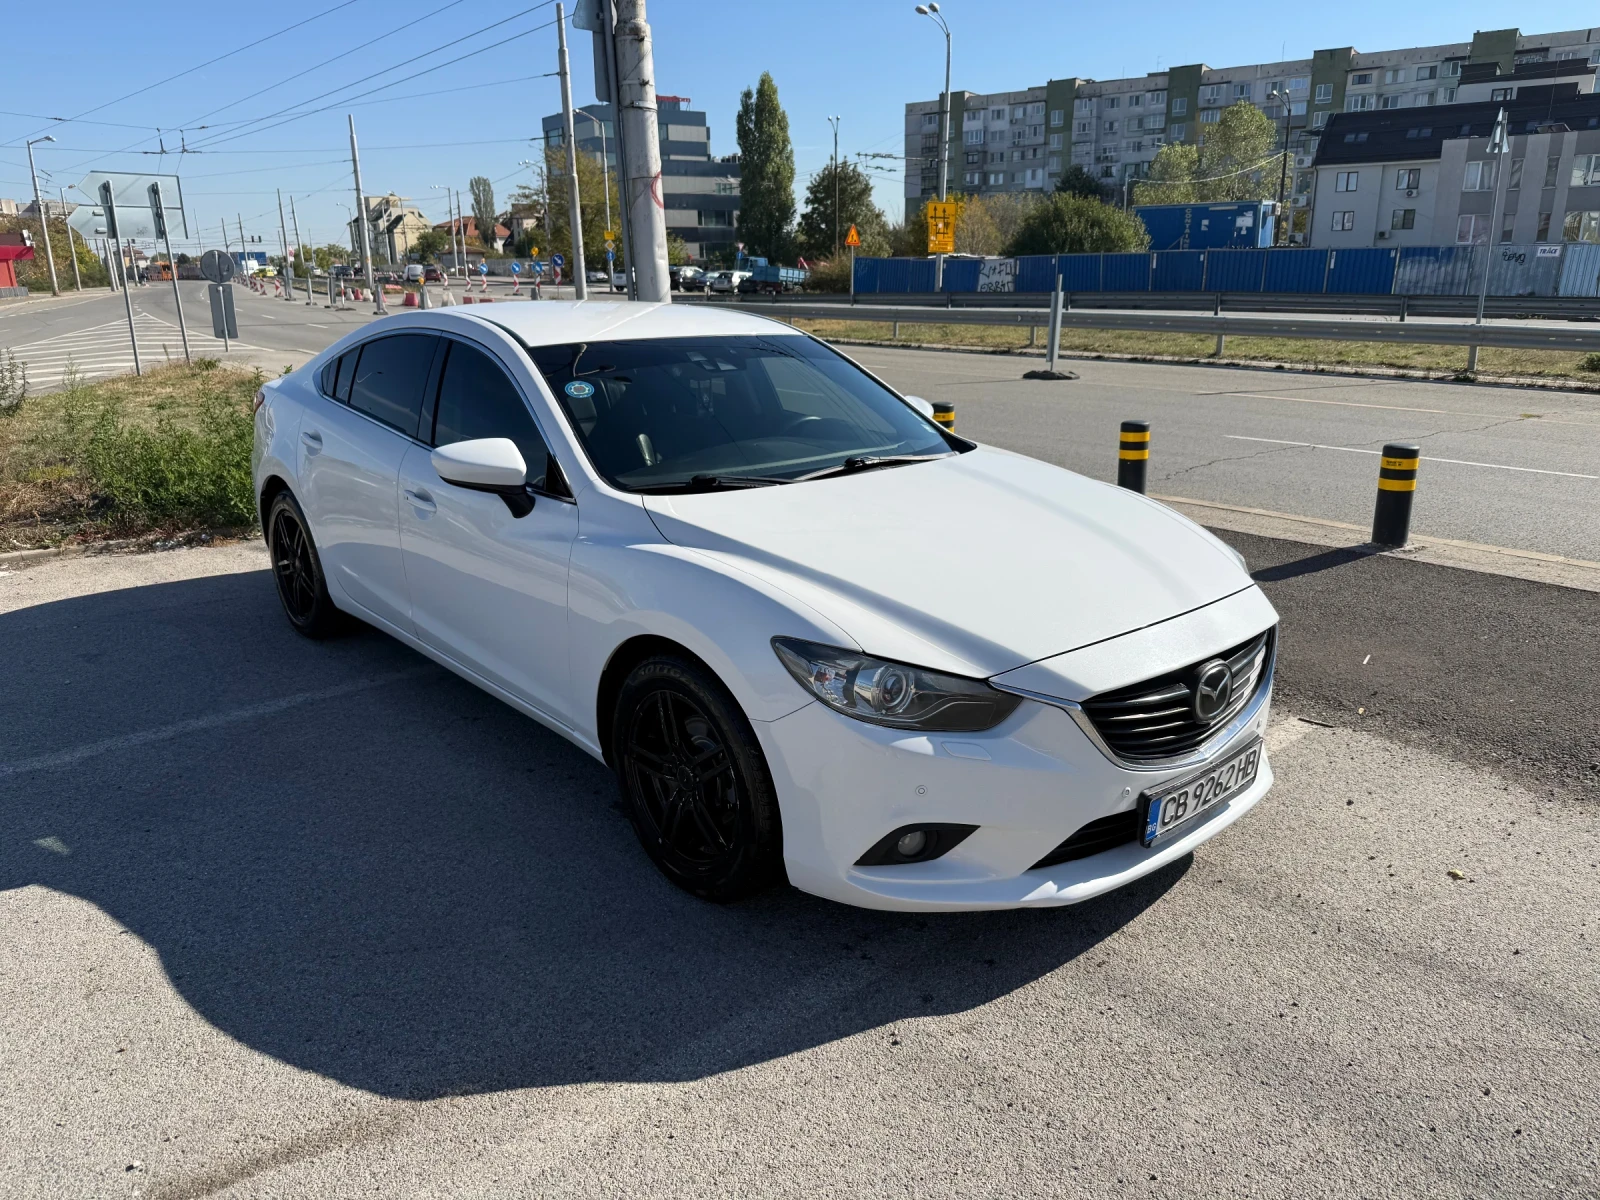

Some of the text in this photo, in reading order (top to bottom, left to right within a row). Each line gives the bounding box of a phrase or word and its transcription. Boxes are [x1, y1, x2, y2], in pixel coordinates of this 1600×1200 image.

[1183, 209, 1192, 250] CONTAINE
[1162, 750, 1257, 826] CB 9262 HB
[1147, 822, 1157, 833] BG
